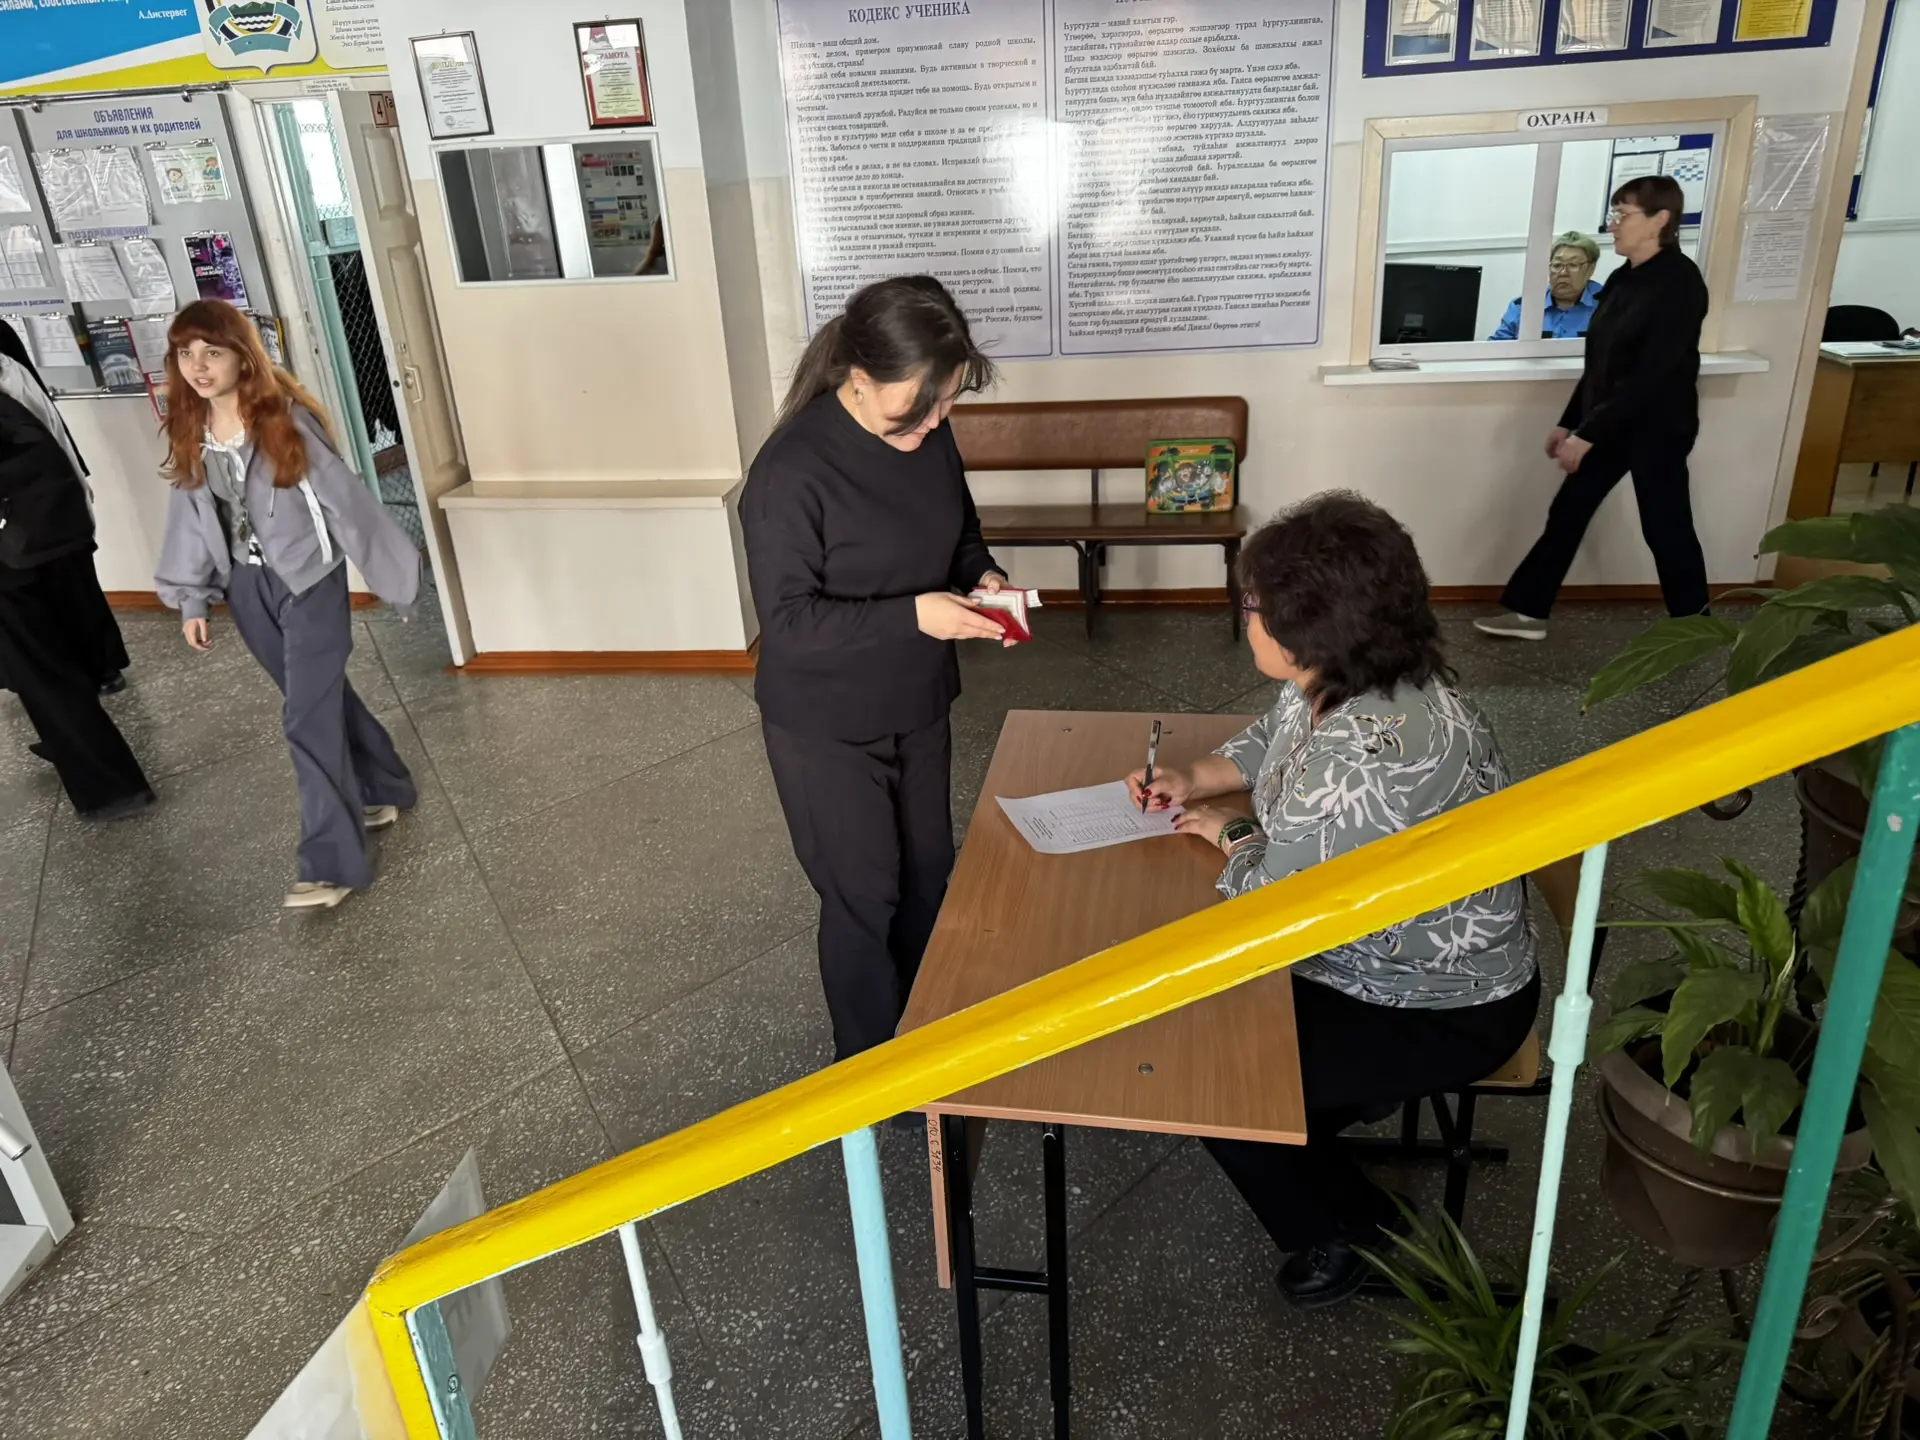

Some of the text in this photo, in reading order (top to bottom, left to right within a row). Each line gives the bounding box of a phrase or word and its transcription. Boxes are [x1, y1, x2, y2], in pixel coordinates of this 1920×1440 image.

[848, 1, 971, 25] КОДЕКС УЧЕНИКА
[825, 49, 849, 57] делом,
[854, 46, 890, 56] примером
[896, 41, 942, 54] приумножай
[948, 42, 969, 50] славу
[975, 38, 1001, 49] родной
[1007, 38, 1035, 46] школы,
[838, 36, 862, 46] общий
[862, 37, 880, 45] дом.
[830, 68, 845, 77] себя
[879, 66, 916, 74] знаниями.
[919, 64, 937, 73] Будь
[940, 63, 977, 71] активным
[987, 58, 1028, 69] творческой
[836, 57, 865, 68] страны!
[860, 78, 911, 88] деятельности.
[835, 90, 864, 100] учитель
[865, 89, 887, 97] всегда
[889, 88, 914, 97] придет
[914, 85, 930, 94] тебе
[941, 84, 972, 92] помощь.
[973, 82, 991, 92] Будь
[992, 81, 1030, 90] открытым
[375, 100, 384, 118] 4
[795, 104, 828, 112] честным.
[826, 110, 861, 120] школьной
[862, 108, 896, 119] дружбой.
[897, 107, 927, 117] Радуйся
[938, 106, 963, 114] только
[987, 103, 1020, 113] успехам,
[93, 107, 154, 123] ОБЪЯВЛЕНИЯ
[1527, 111, 1596, 128] ОХРАНА
[56, 117, 201, 141] для школьников и их родителей
[848, 120, 888, 130] товарищей.
[841, 132, 878, 141] культурно
[898, 128, 915, 137] себя
[829, 142, 860, 151] Заботься
[897, 139, 944, 148] поддержании
[947, 135, 981, 146] традиций
[837, 162, 853, 171] себя
[861, 163, 884, 171] делах,
[941, 156, 980, 166] Исправляй
[854, 174, 870, 182] дело
[871, 173, 880, 181] до
[880, 172, 904, 180] конца.
[900, 178, 955, 188] останавливайся
[866, 191, 914, 201] приобретении
[916, 188, 944, 197] знаний.
[945, 188, 979, 196] Относись
[843, 214, 871, 222] спортом
[895, 209, 928, 220] здоровый
[928, 209, 948, 218] образ
[976, 266, 1002, 274] сейчас.
[989, 285, 1010, 293] малой
[1013, 286, 1041, 294] родины.
[995, 304, 1042, 313] своей страны,
[1013, 314, 1042, 323] будущее
